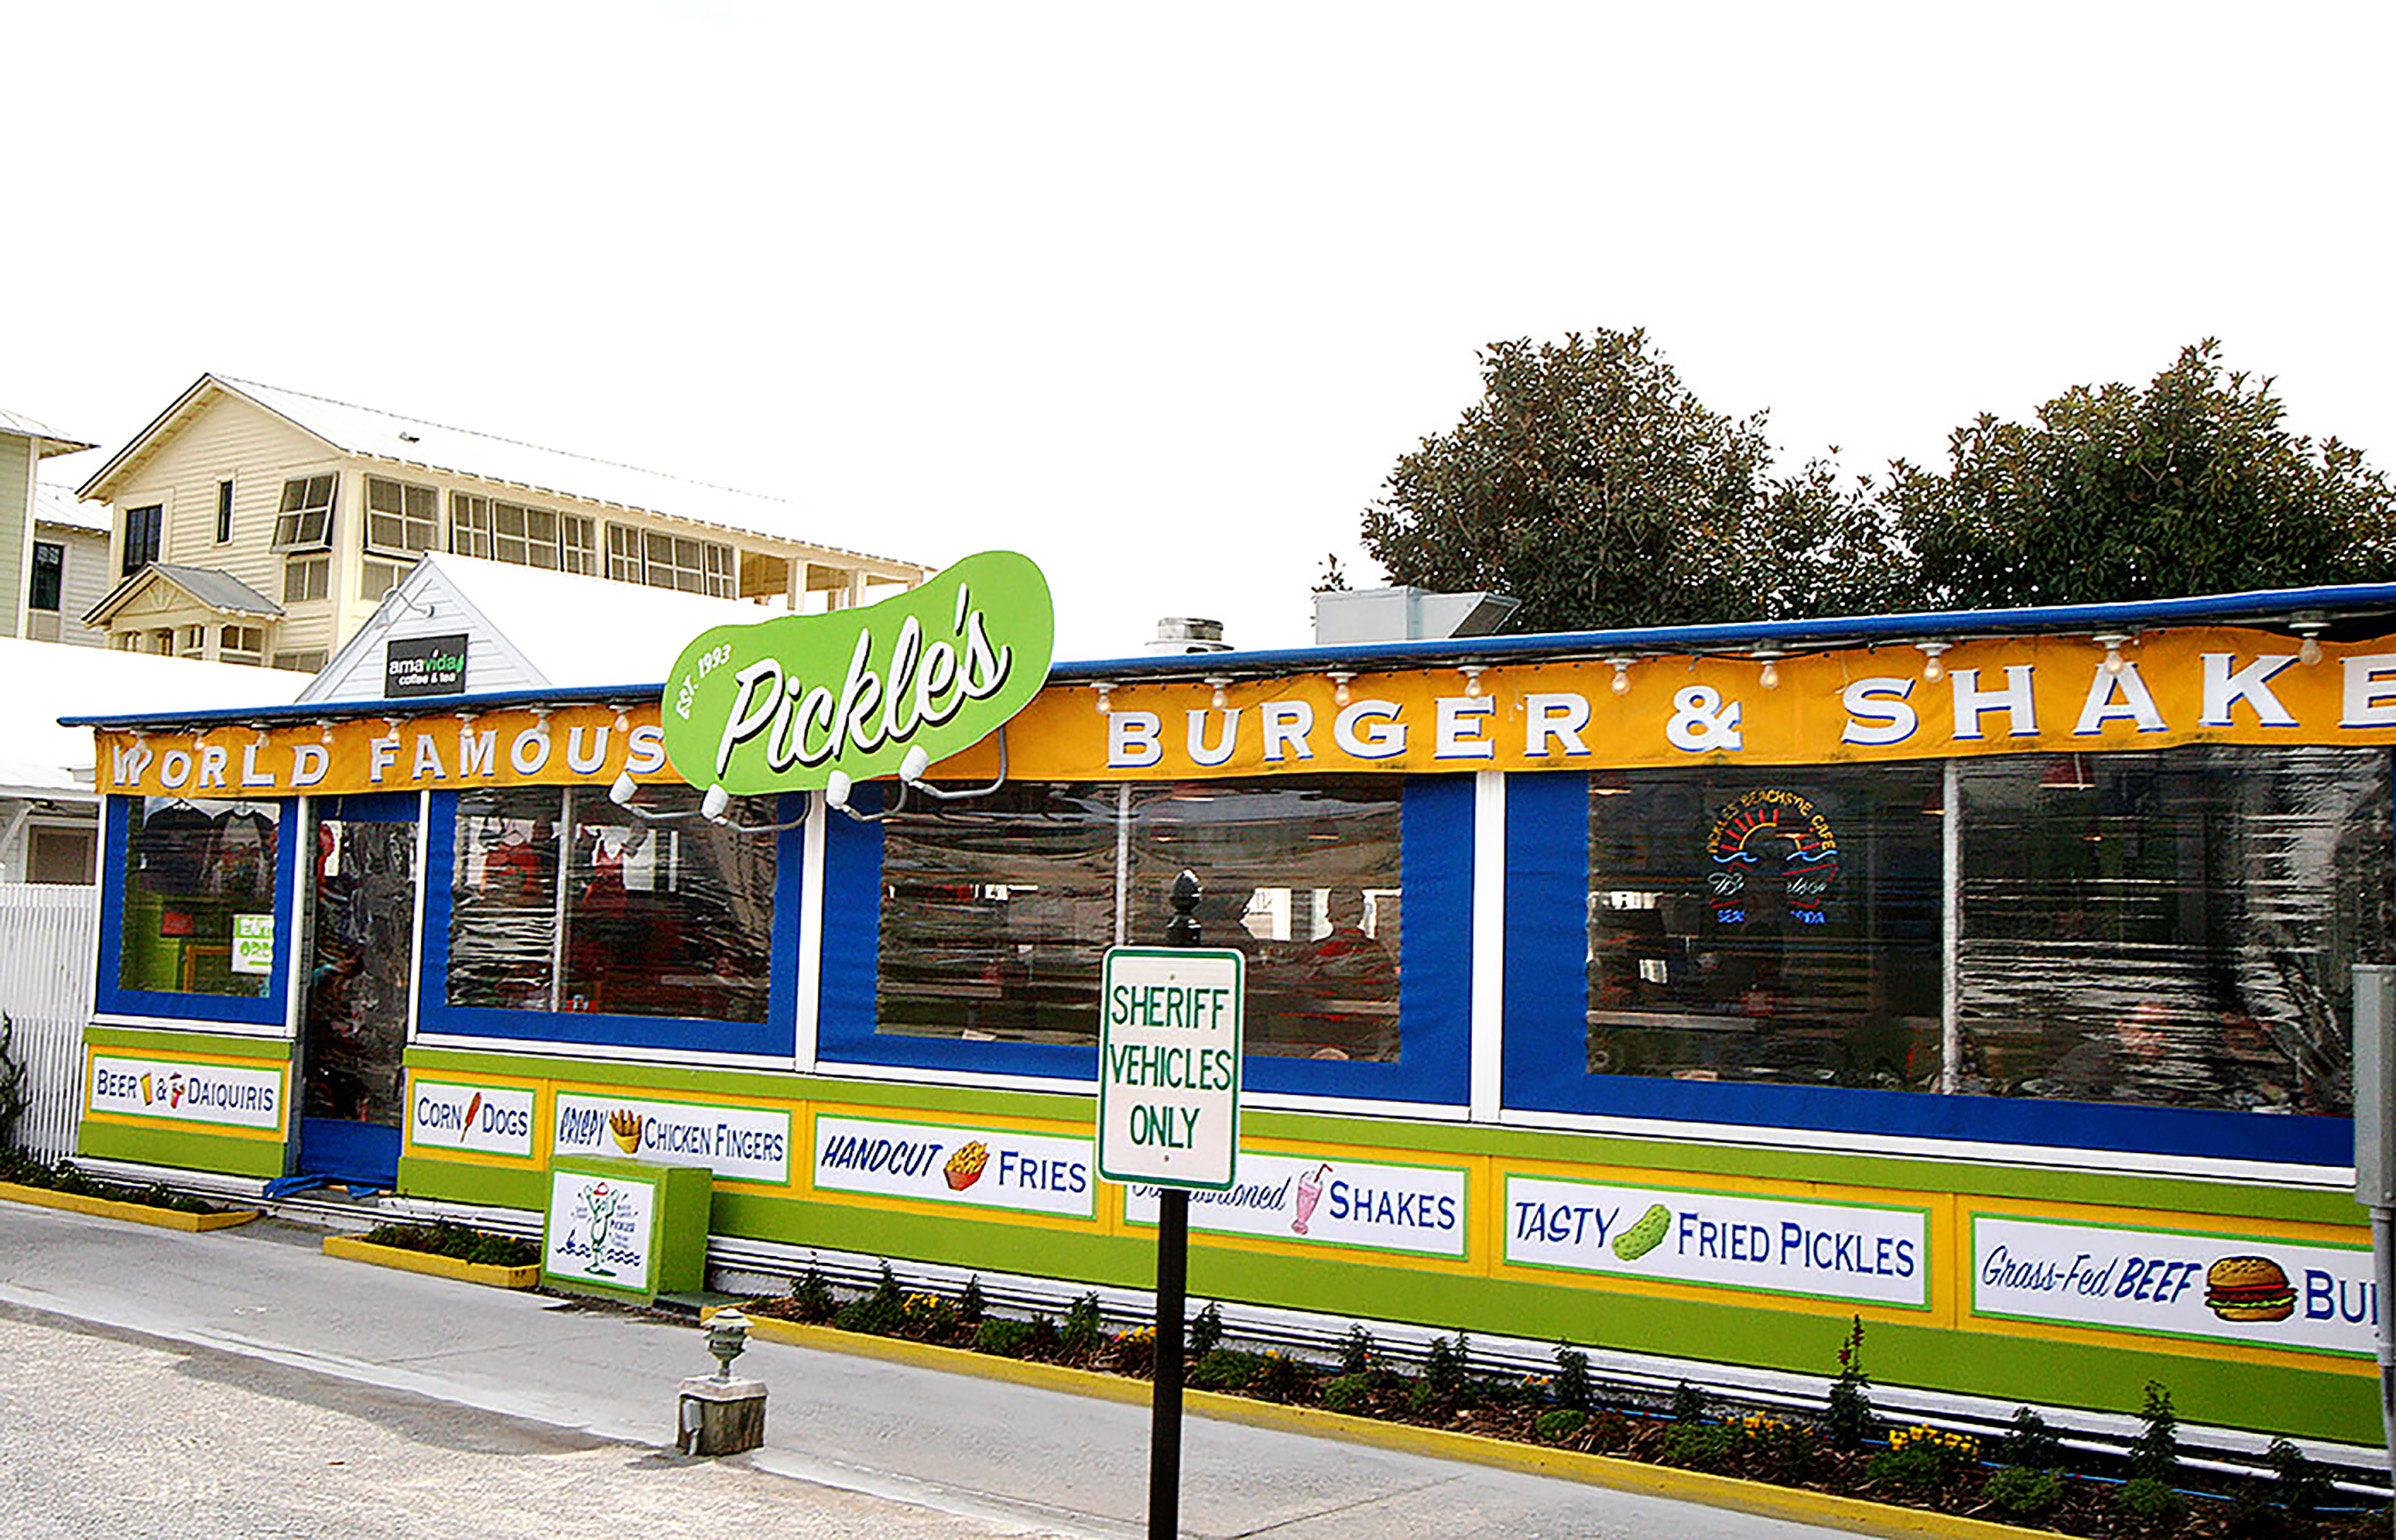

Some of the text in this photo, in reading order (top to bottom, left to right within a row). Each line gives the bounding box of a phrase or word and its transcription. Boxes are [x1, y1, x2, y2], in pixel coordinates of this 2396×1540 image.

[389, 649, 458, 675] amavida
[676, 643, 732, 720] EST. 1993
[715, 582, 1012, 780] Pickle's
[1106, 652, 2396, 769] BURGER & SHAKE
[112, 726, 667, 788] WORLD FAMOUS
[1811, 814, 1837, 851] CAFE
[1111, 985, 1230, 1030] SHERIFF
[97, 1069, 274, 1112] BEER & DAIQUIRIS
[1109, 1044, 1233, 1091] VEHICLES
[417, 1096, 529, 1137] CORN DOGS
[644, 1117, 713, 1154] CHICKEN
[713, 1123, 784, 1162] FINGERS
[1130, 1104, 1202, 1149] ONLY
[821, 1135, 1087, 1194] HANDCUT FRIES
[1329, 1180, 1457, 1231] SHAKES
[1515, 1202, 1916, 1279] TASTY FRIED PICKLES
[1981, 1244, 2378, 1326] Grass-Fed BEEF BU
